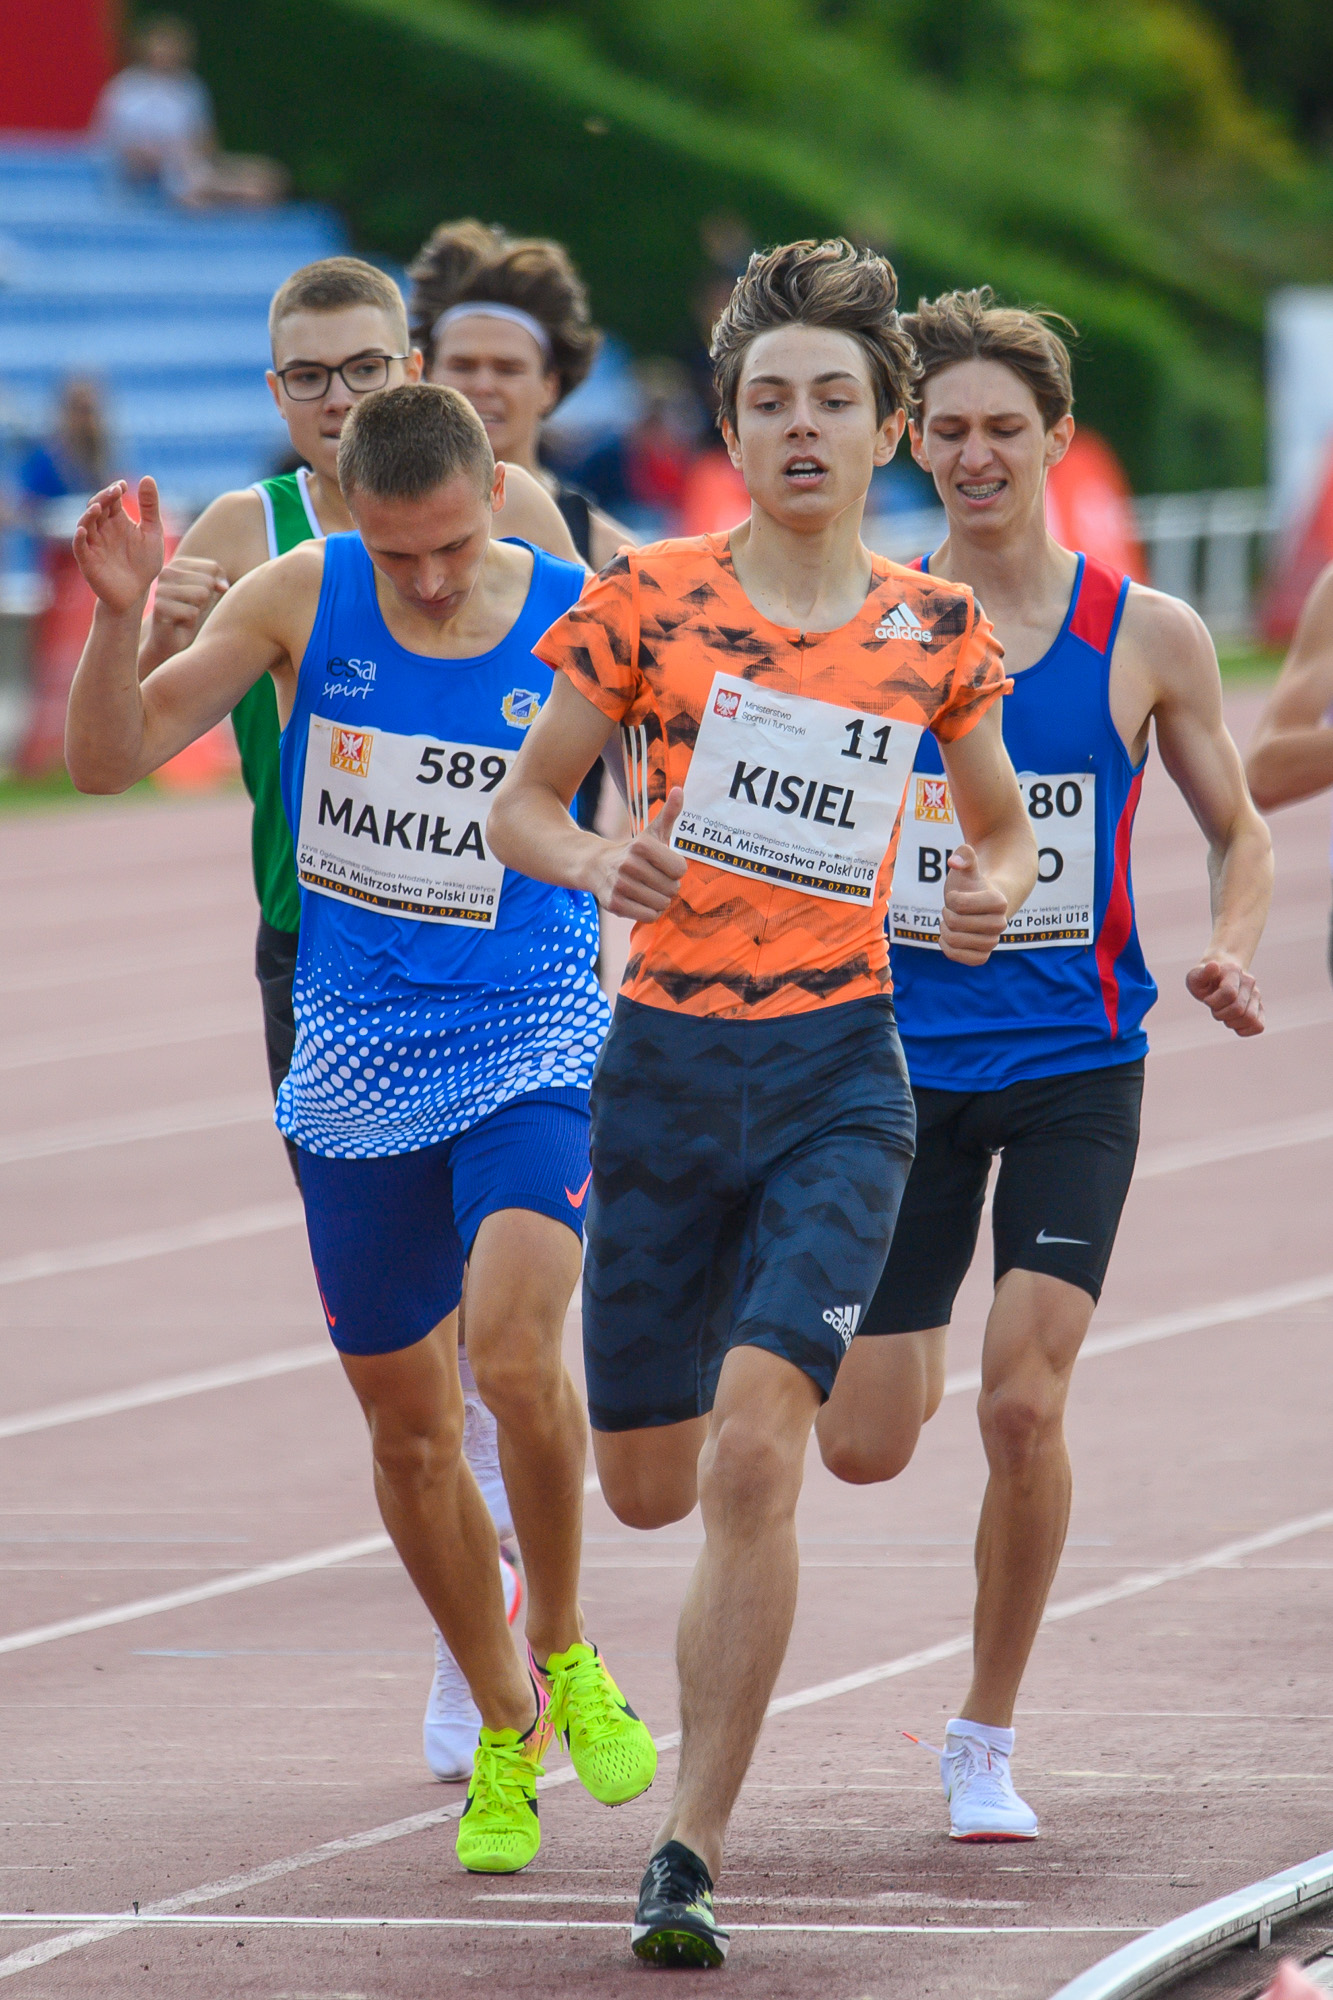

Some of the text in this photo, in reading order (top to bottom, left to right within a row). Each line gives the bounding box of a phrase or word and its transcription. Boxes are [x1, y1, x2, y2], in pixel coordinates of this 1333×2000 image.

[875, 625, 933, 643] adidas
[321, 679, 375, 700] spirt
[741, 711, 767, 726] Sportu
[772, 719, 807, 735] Turystyki
[744, 701, 792, 721] Ministerstwo
[840, 718, 892, 765] 11
[415, 746, 507, 793] 589
[728, 760, 856, 830] KISIEL
[1019, 781, 1083, 819] 80
[317, 788, 486, 861] MAKIŁA
[703, 817, 751, 837] Ogólnopolska
[752, 832, 790, 849] Olimpiada
[677, 839, 868, 897] BIELSKO-BIAŁA 15-17.07.2022
[678, 820, 875, 881] 54. PZLA Mistrzostwa Polski U18
[299, 852, 495, 906] 54. PZLA Mistrzostwa Polski U18
[361, 864, 396, 879] Olimpiada
[893, 912, 940, 927] 54. PZLA
[1003, 930, 1086, 943] 15-17.07.2022
[1026, 914, 1062, 927] Polski
[1065, 911, 1090, 924] U18
[822, 1309, 852, 1351] adida
